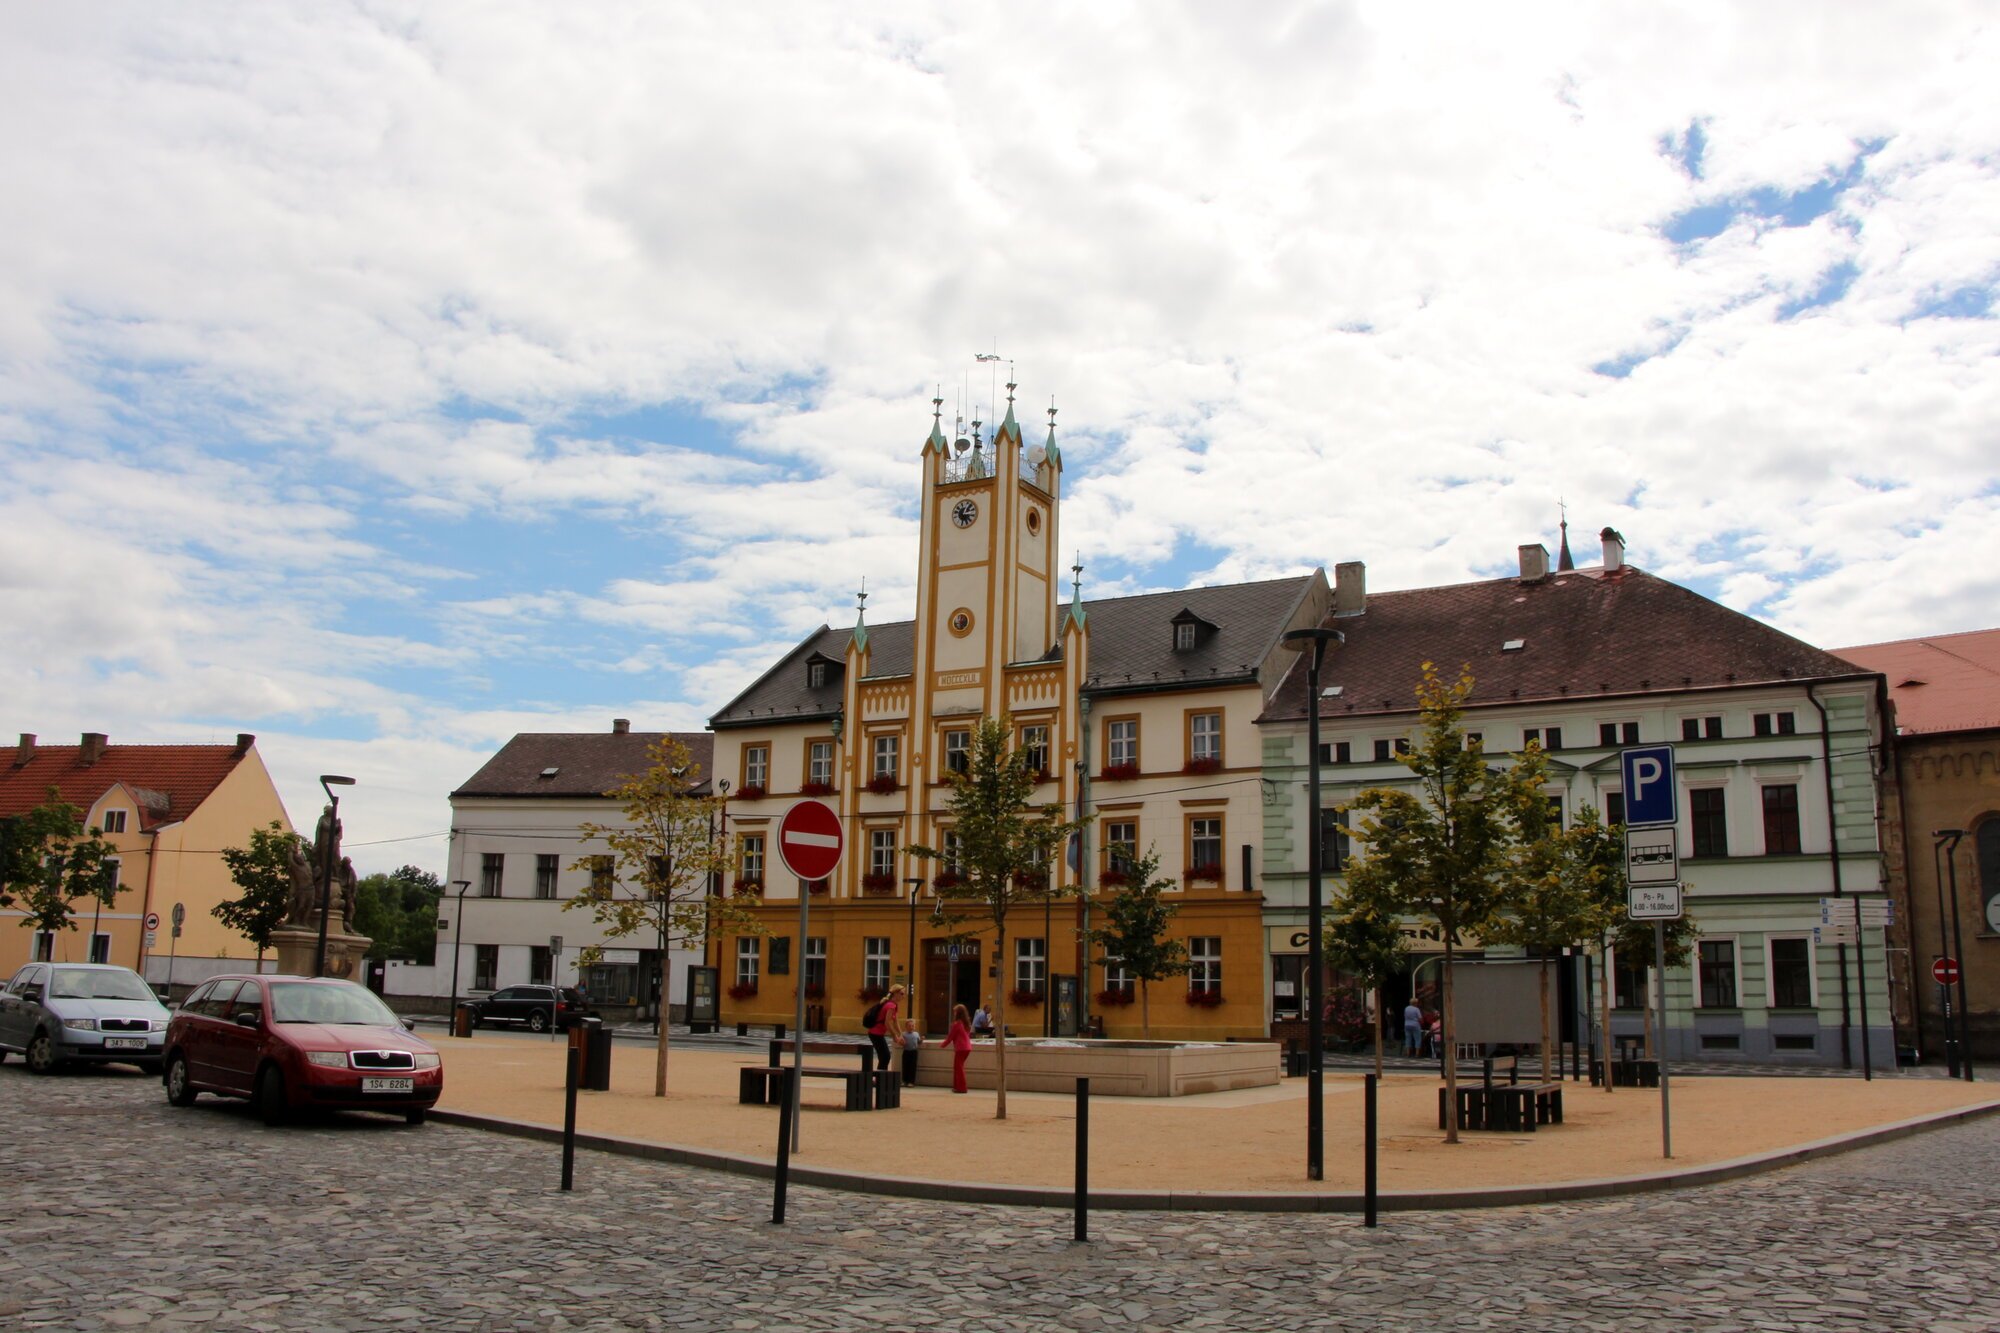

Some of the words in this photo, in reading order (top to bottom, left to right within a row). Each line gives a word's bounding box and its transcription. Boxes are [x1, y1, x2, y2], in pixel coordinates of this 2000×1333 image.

[1632, 757, 1662, 801] P
[935, 944, 978, 955] RAICE
[370, 1080, 384, 1089] 1S4
[389, 1080, 409, 1089] 6284
